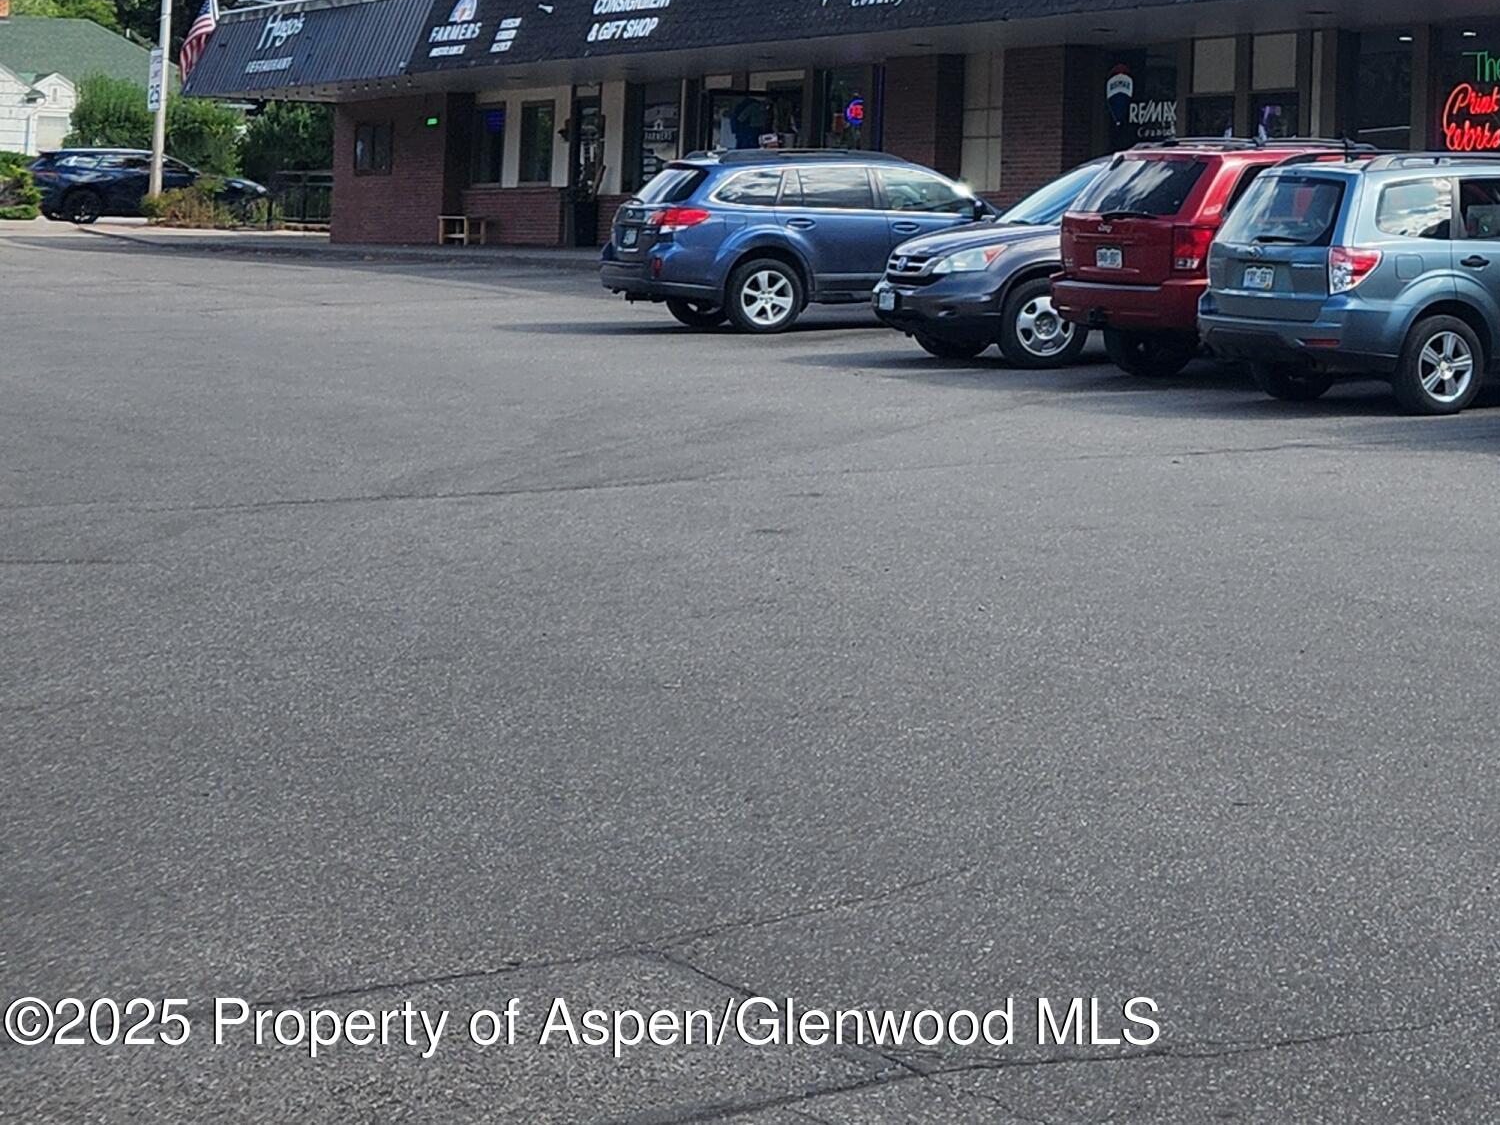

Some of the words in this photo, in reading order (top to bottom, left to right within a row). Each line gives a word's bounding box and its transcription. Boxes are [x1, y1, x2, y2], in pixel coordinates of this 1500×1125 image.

[428, 21, 482, 43] FARMERS
[586, 22, 600, 42] &
[597, 19, 628, 41] GIFT
[622, 17, 659, 39] SHOP
[1443, 82, 1500, 123] Print
